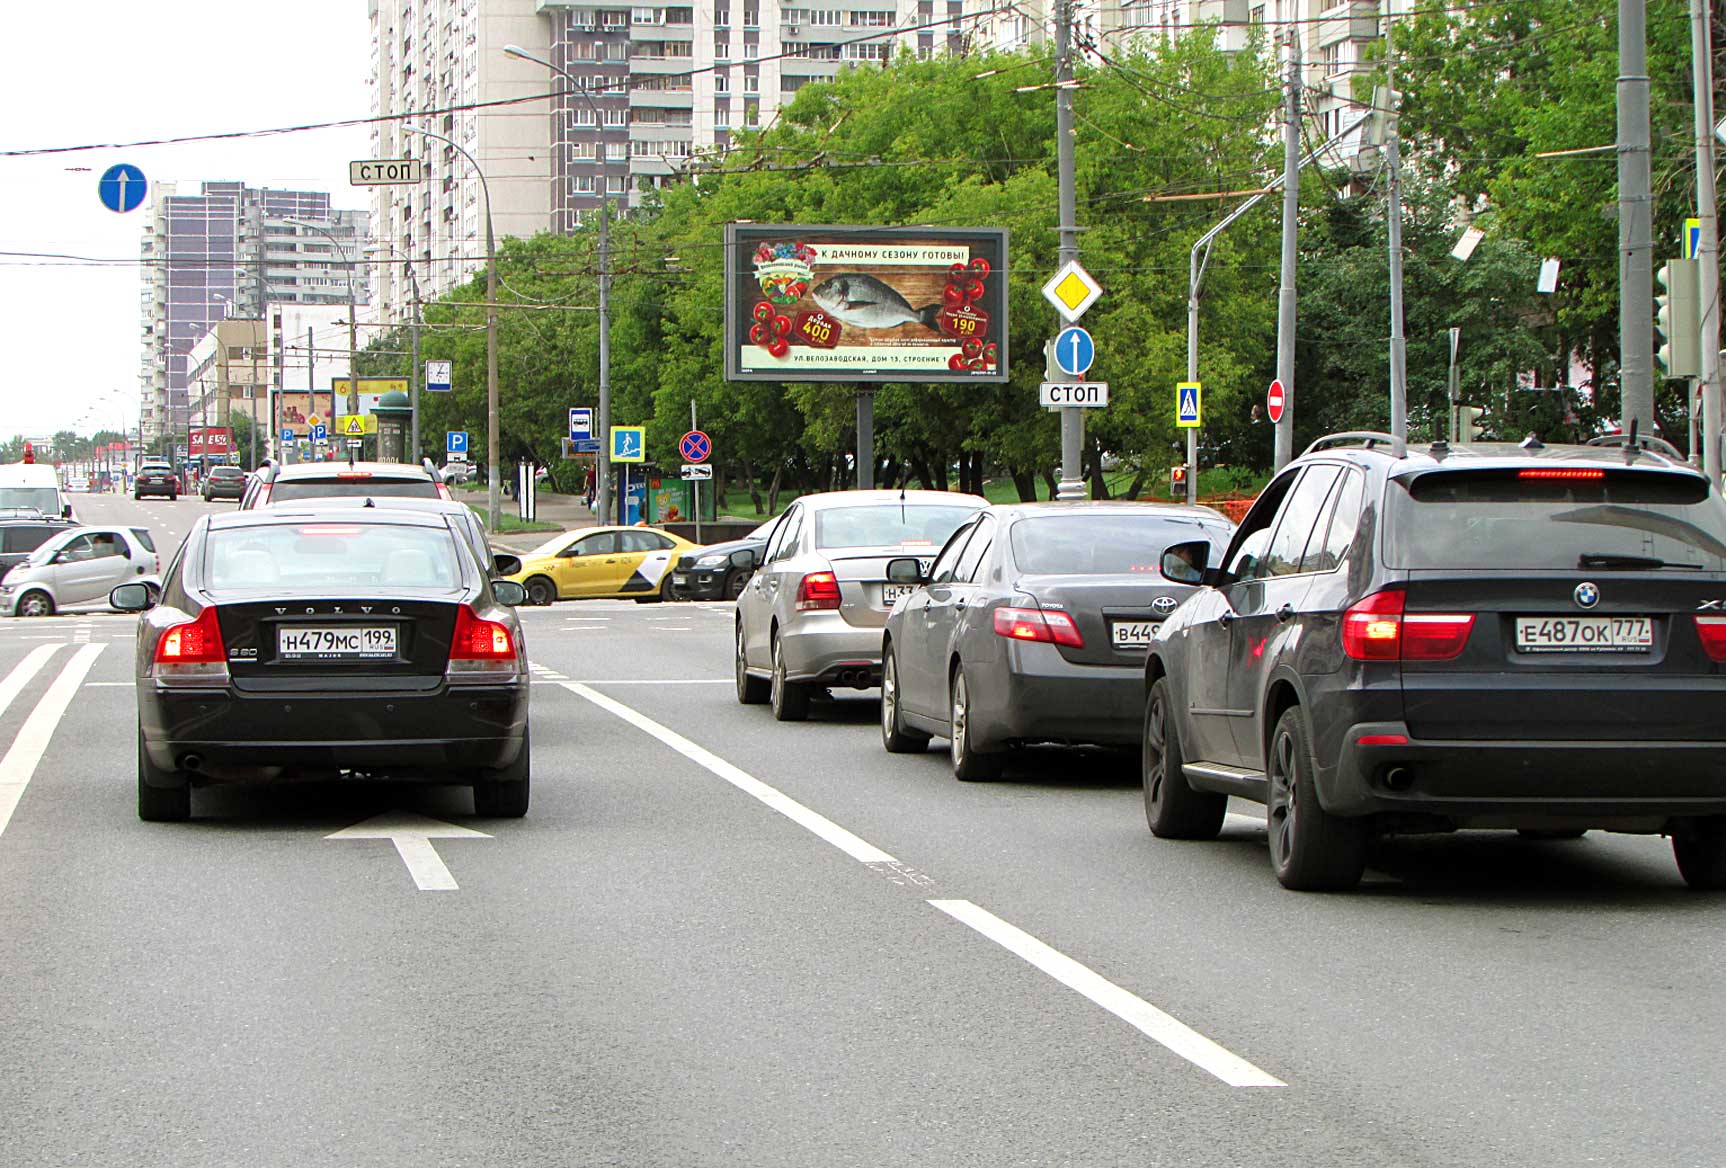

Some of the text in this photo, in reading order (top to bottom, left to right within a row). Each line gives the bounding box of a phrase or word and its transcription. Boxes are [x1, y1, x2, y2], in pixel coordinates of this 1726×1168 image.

[361, 165, 410, 180] СТОП
[821, 250, 964, 259] К ДАЧНОМУ СЕЗОНУ ГОТОВЫ!
[803, 322, 830, 341] 400
[953, 318, 976, 331] 190
[1050, 386, 1098, 402] СТОП
[192, 434, 214, 445] SAE
[274, 606, 400, 615] VOLVO
[1696, 600, 1726, 610] X
[1524, 619, 1645, 642] Е487ОК 777
[286, 630, 392, 650] Н479МС 199
